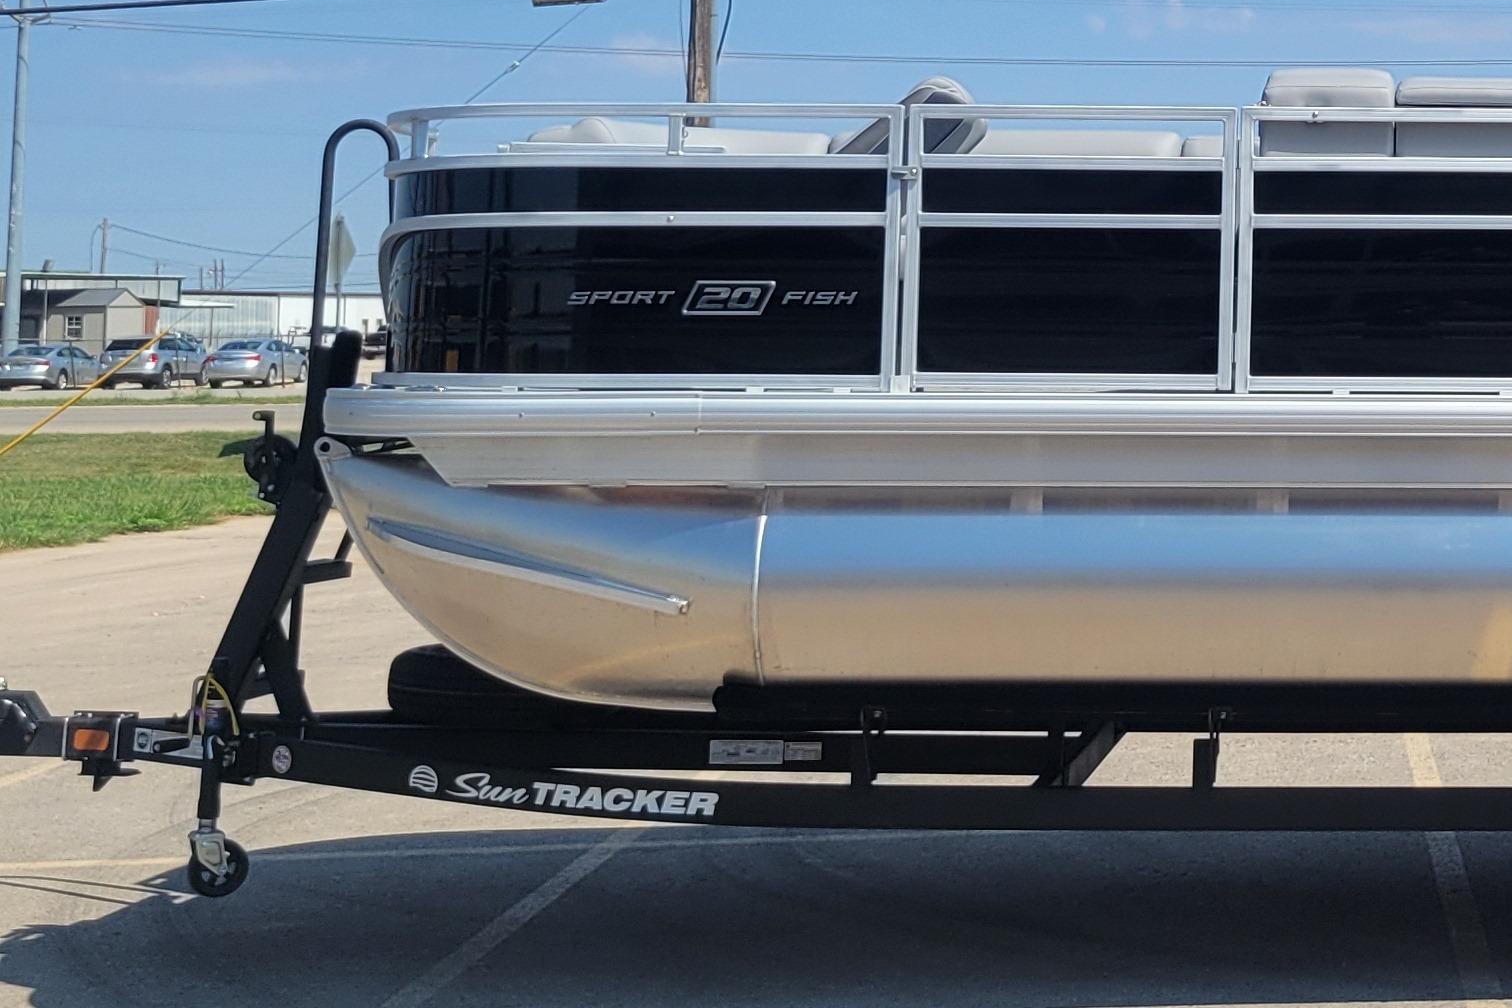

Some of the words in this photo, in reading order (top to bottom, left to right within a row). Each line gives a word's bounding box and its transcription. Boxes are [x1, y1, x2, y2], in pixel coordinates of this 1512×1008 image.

[567, 290, 676, 306] SPORT
[694, 286, 763, 310] 20
[781, 290, 858, 306] FISH
[445, 772, 531, 805] Sun
[531, 781, 720, 817] TRACKER
